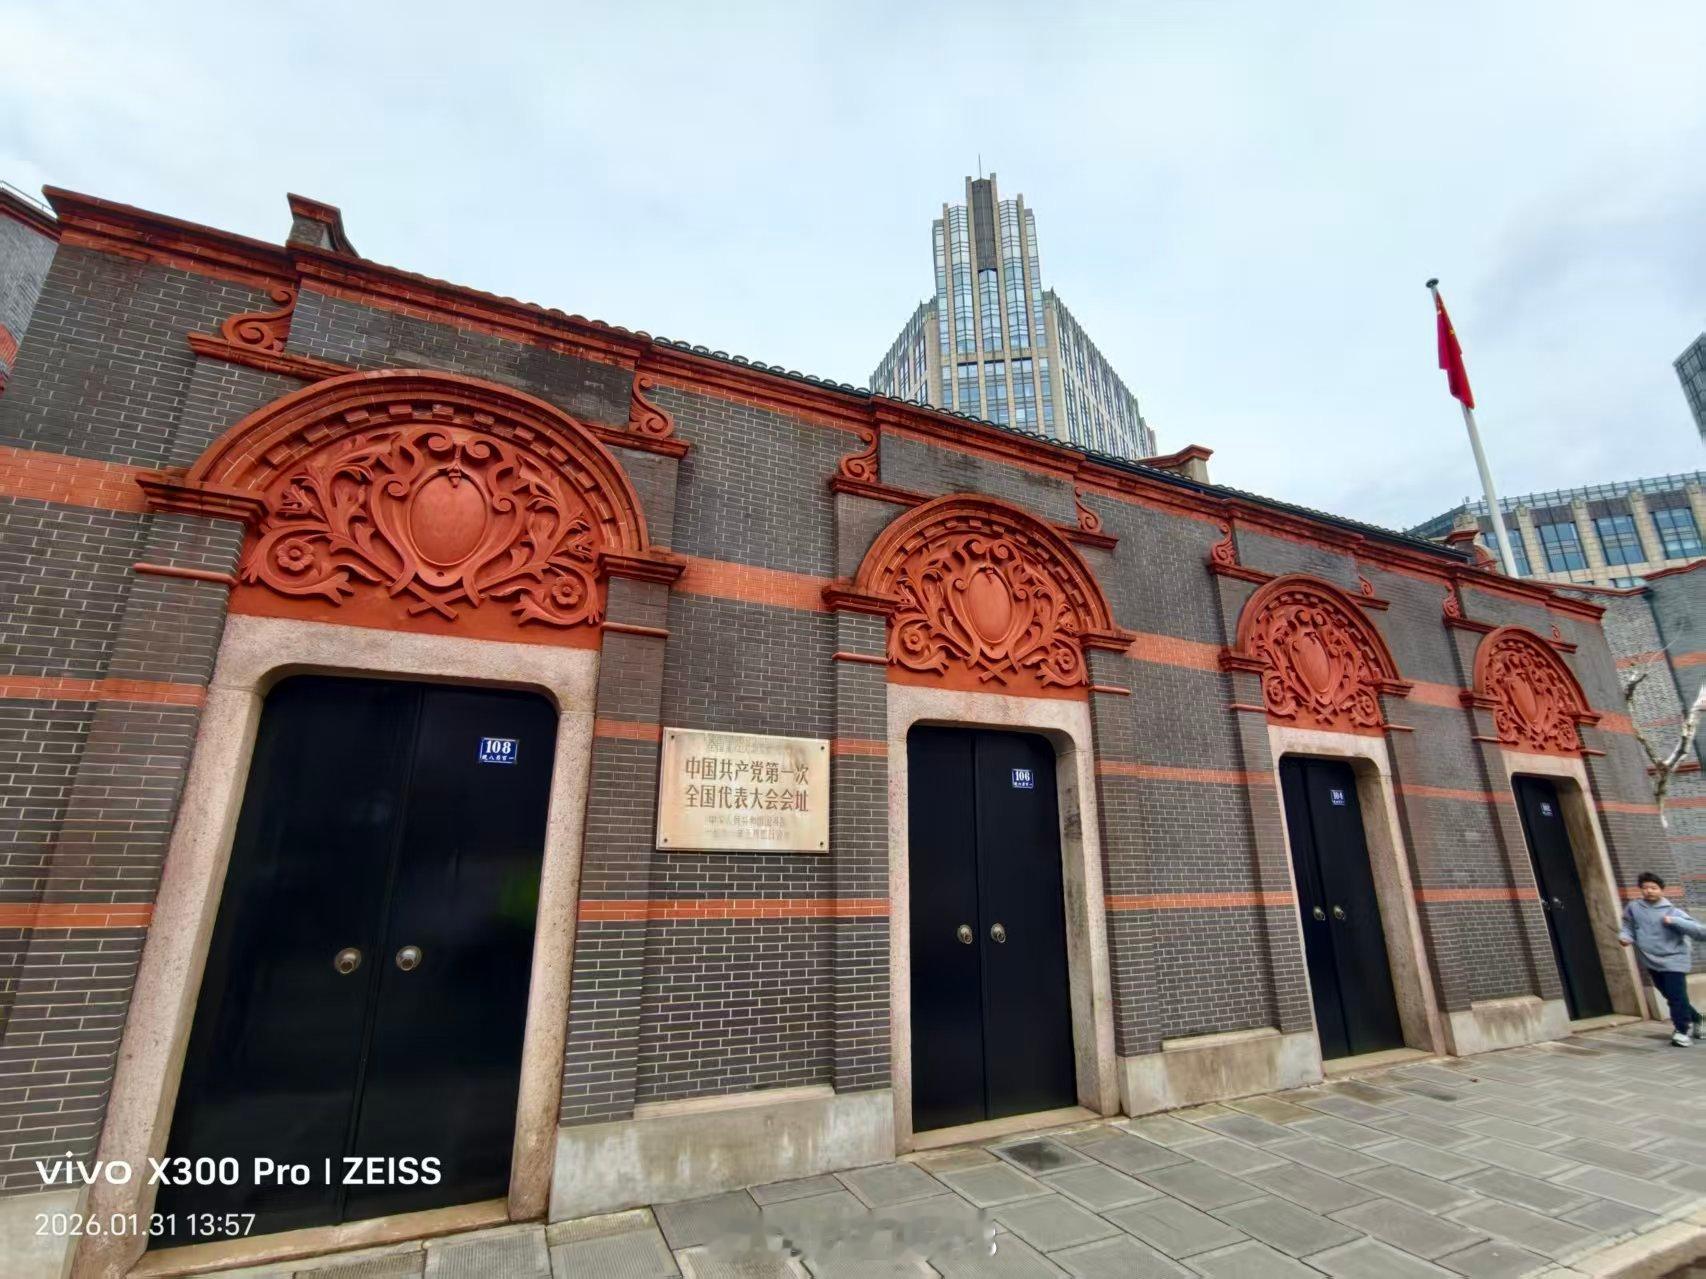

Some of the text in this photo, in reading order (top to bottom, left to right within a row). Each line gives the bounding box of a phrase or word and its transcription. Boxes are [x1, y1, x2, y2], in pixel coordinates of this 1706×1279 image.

[486, 740, 511, 754] 108
[685, 756, 809, 785] 中国共产党第一次
[1015, 771, 1030, 781] 106
[685, 784, 809, 812] 全国代表大会会址
